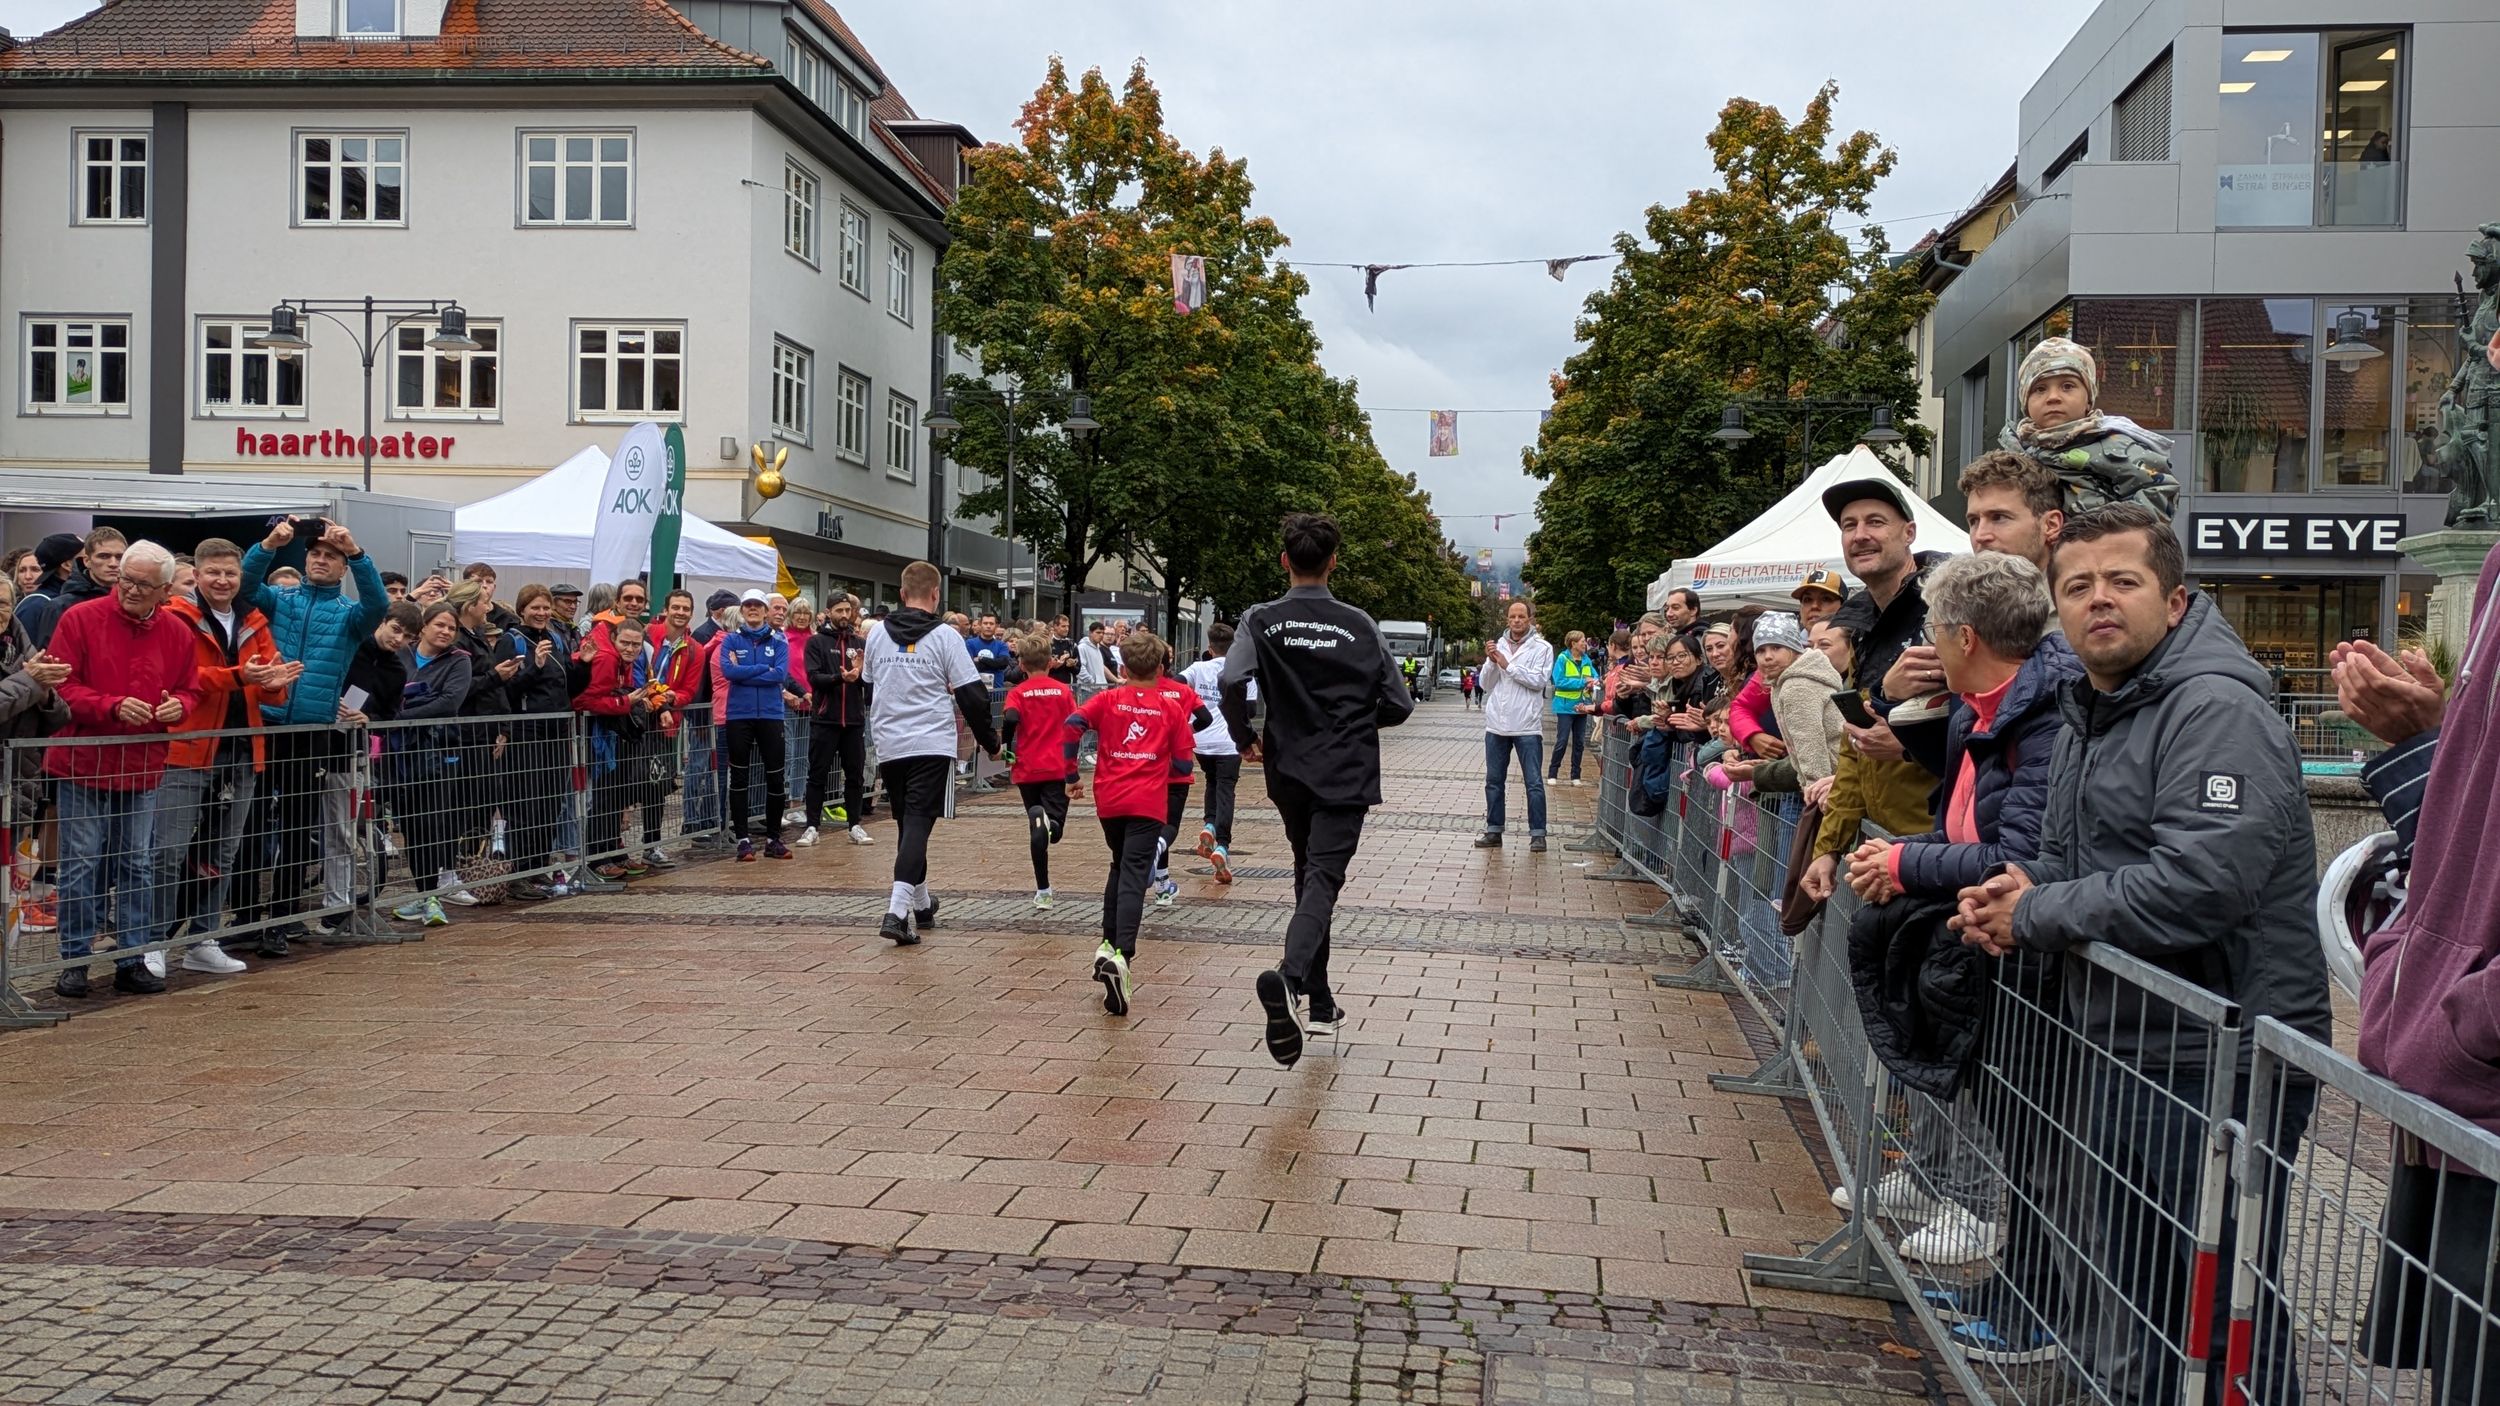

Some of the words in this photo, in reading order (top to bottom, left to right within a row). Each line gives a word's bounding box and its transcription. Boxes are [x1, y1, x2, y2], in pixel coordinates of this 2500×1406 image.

[2236, 182, 2312, 191] STRABINGER
[236, 427, 455, 458] haartheater
[611, 488, 653, 514] AOK
[2197, 518, 2290, 550] EYE
[2306, 519, 2400, 551] EYE
[1710, 561, 1828, 580] LEICHTATHLETIK
[1264, 623, 1283, 638] TSV
[1285, 620, 1356, 643] Oberdigisheim
[1283, 636, 1338, 649] Volleyball
[1117, 704, 1132, 712] TSG
